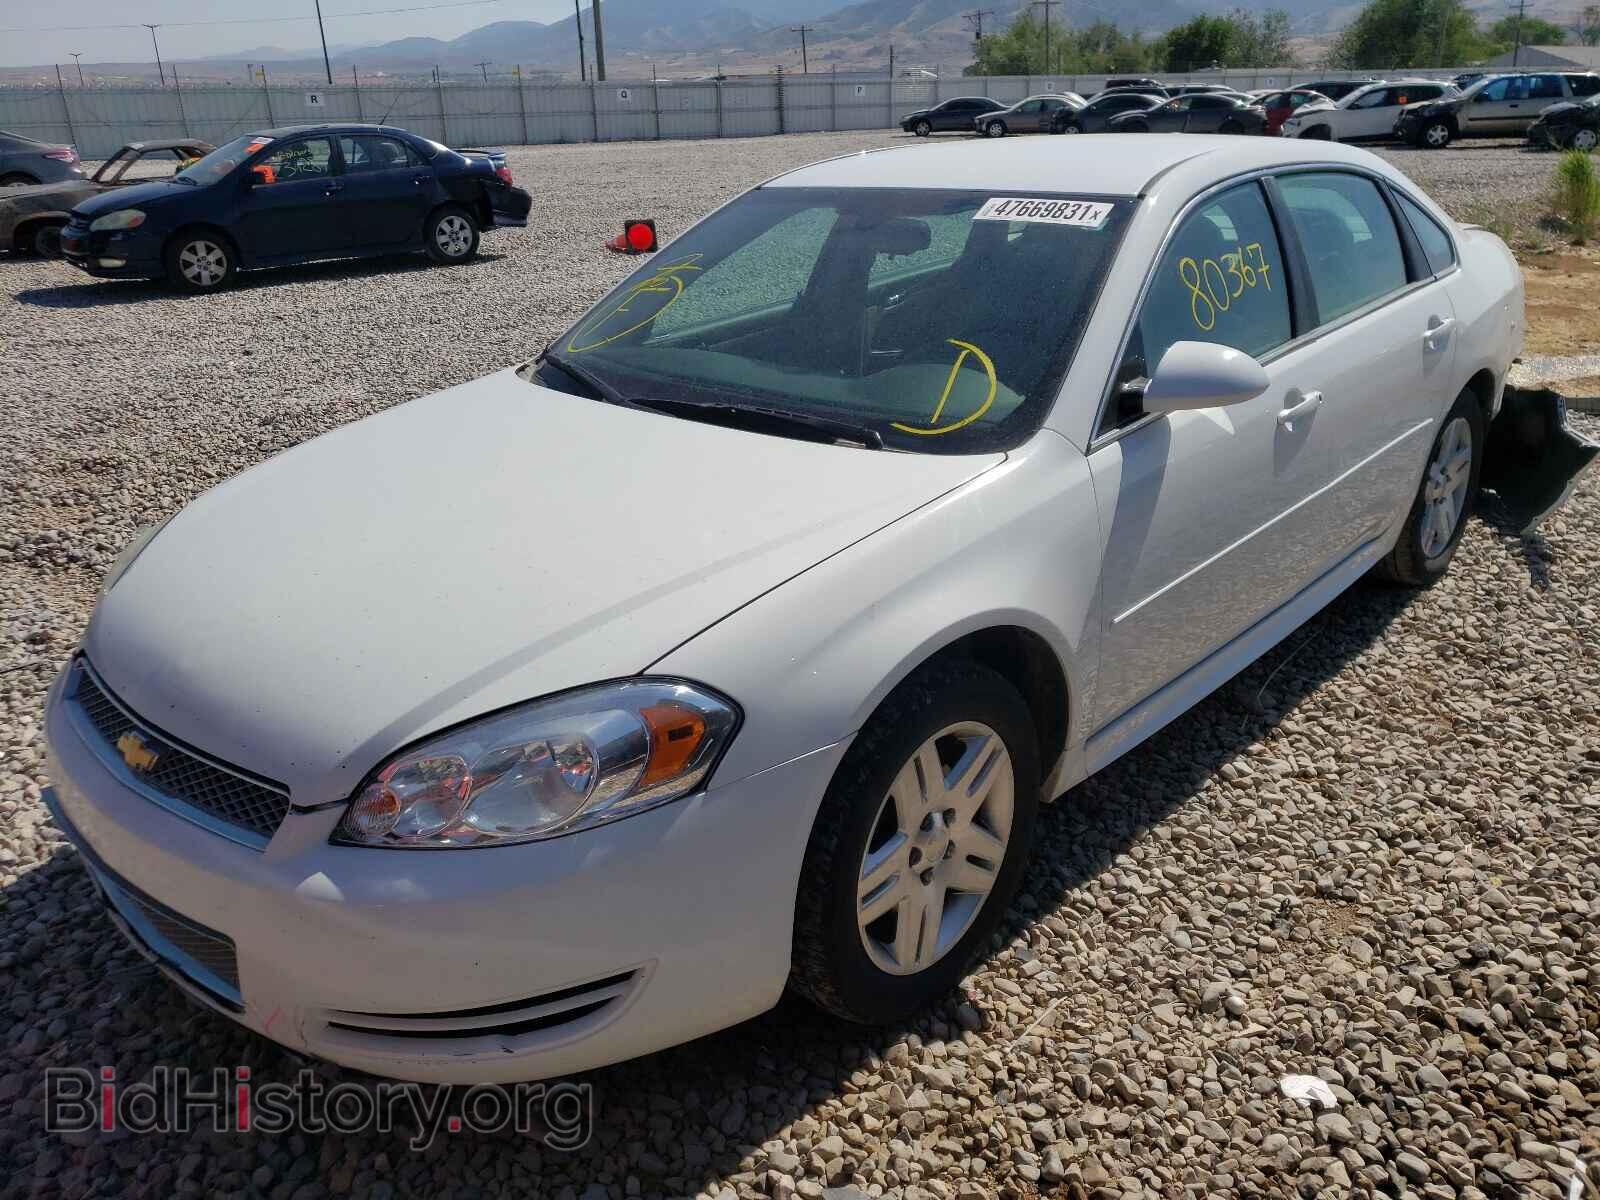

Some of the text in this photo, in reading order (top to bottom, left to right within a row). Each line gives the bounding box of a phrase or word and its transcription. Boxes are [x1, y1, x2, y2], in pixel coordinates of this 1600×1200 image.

[310, 95, 319, 104] R
[994, 200, 1093, 220] 47669831
[1179, 243, 1271, 330] 80367
[890, 338, 997, 435] D
